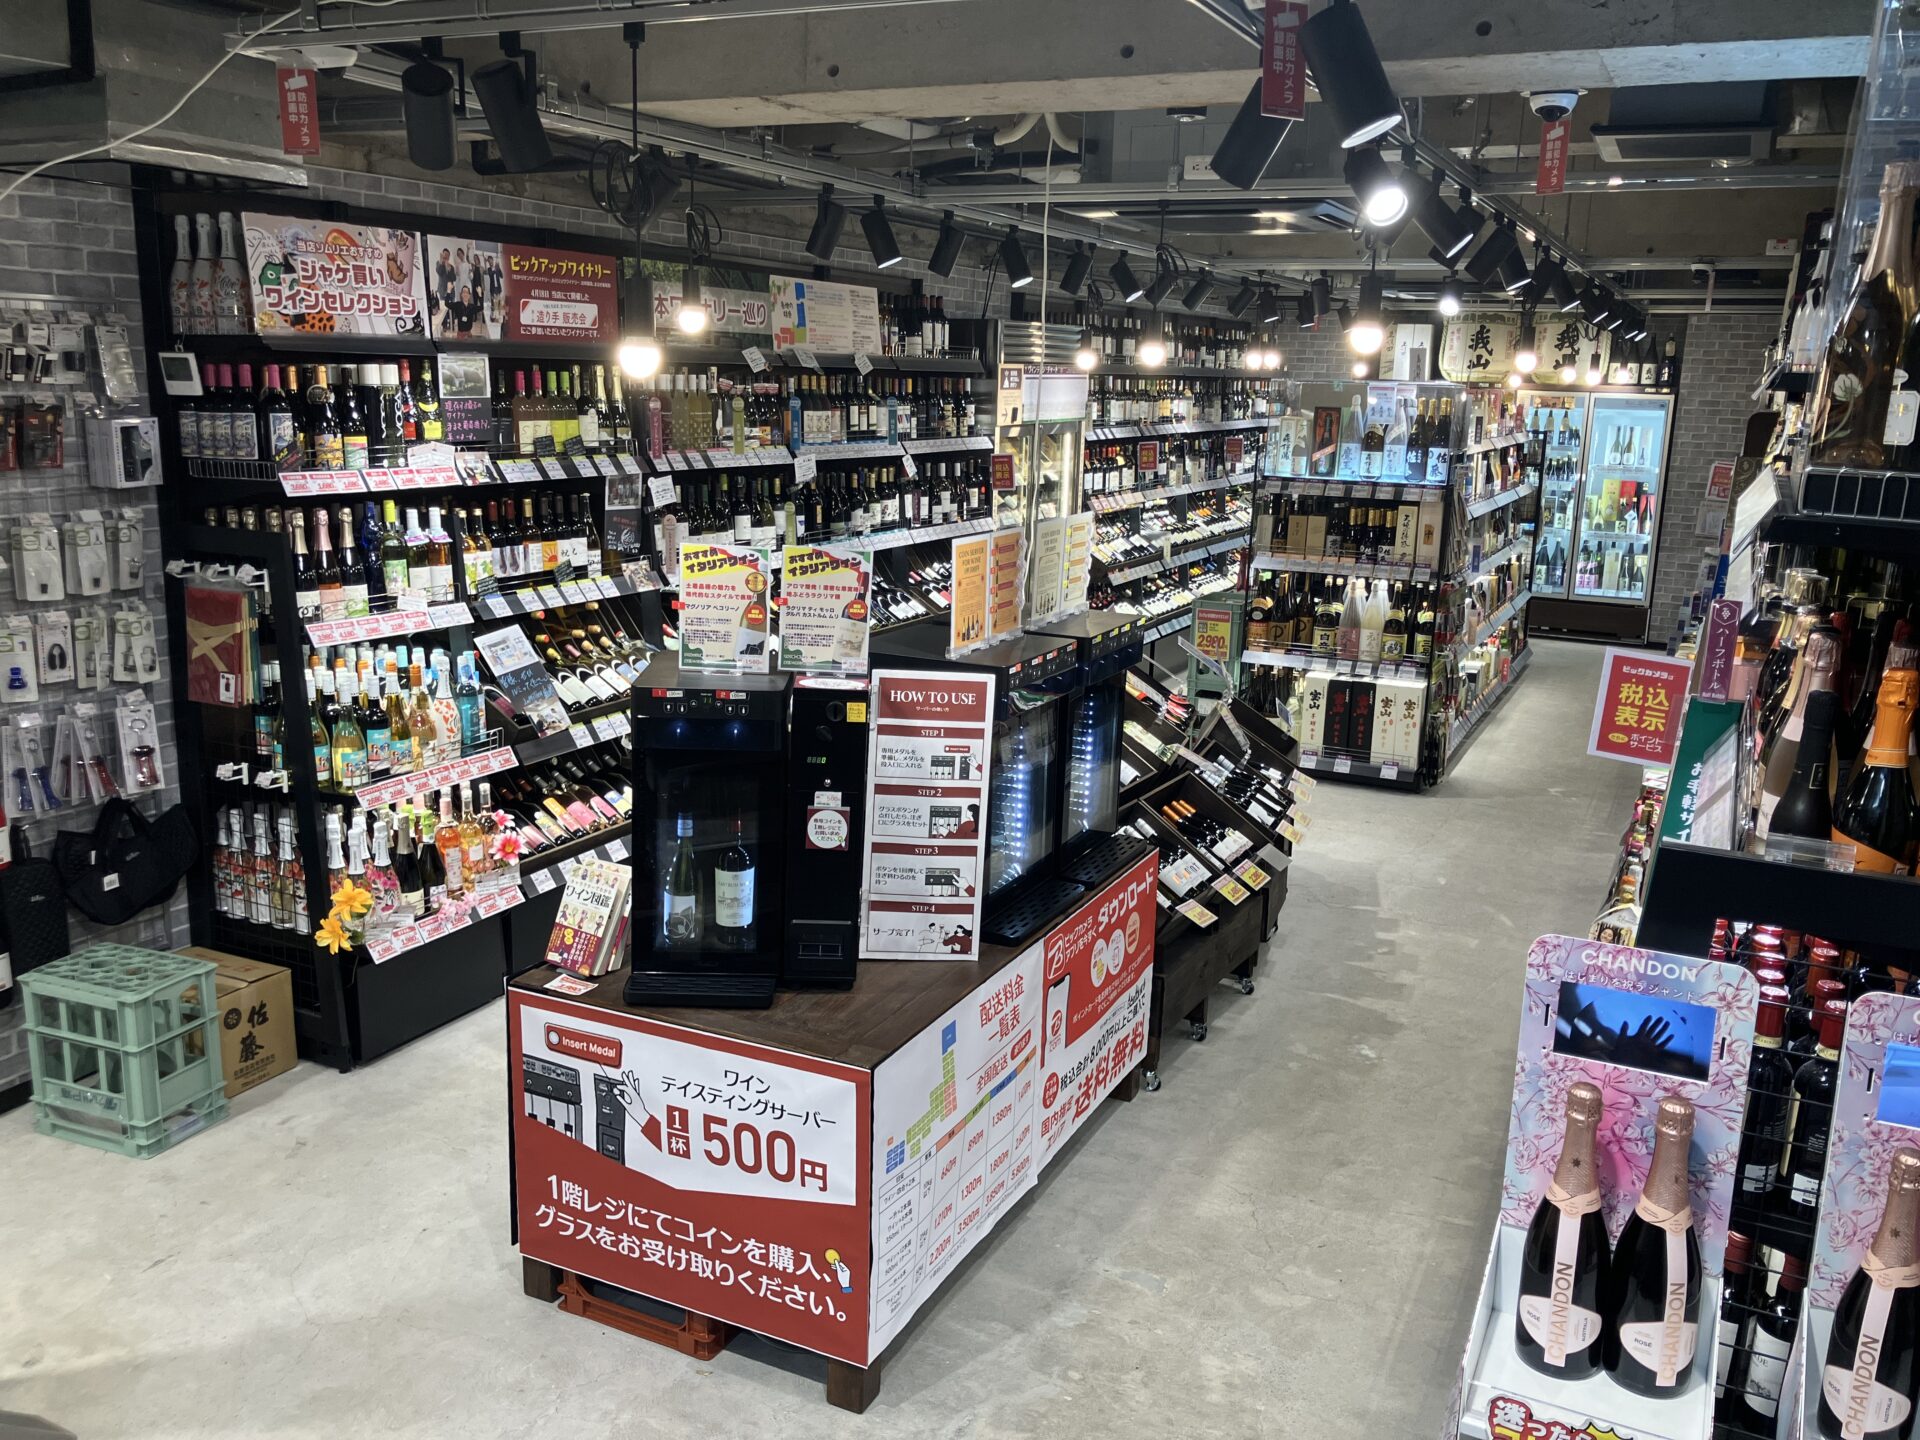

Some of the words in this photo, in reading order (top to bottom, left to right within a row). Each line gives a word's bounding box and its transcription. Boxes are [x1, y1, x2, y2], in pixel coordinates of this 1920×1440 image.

[1284, 32, 1296, 104] 防犯カメラ
[297, 91, 310, 146] 防犯カメラ
[297, 240, 383, 260] 当店ソムリエおすすめ
[300, 259, 386, 287] ジャケ買い
[510, 255, 612, 279] ピックアップワイナリー
[264, 287, 417, 316] ワインセレクション
[683, 548, 718, 561] おすすめ
[686, 553, 759, 573] イタリアワイン
[788, 557, 861, 577] イタリアワイン
[789, 551, 823, 564] おすすめ
[1708, 628, 1729, 690] ハーフボトル
[890, 690, 926, 703] HOW
[928, 691, 948, 704] TO
[951, 693, 976, 705] USE
[1619, 682, 1669, 711] 税込
[940, 728, 944, 737] 1
[1614, 705, 1666, 731] 表示
[1630, 733, 1665, 744] ポイント
[1630, 741, 1662, 753] サービス
[936, 788, 942, 796] 2
[878, 820, 928, 828] 口にグラスをセット
[933, 847, 939, 855] 3
[566, 885, 612, 908] ワイン図鑑
[1098, 867, 1154, 933] ダウンロード
[1064, 915, 1093, 946] ビックカメラ
[1065, 925, 1098, 964] アプリを今すぐ
[1581, 950, 1697, 983] CHANDON
[979, 973, 1024, 1028] 配送料金
[1565, 971, 1702, 1001] はじまりを祝うシャンド
[988, 1004, 1020, 1042] 一覧表
[562, 1036, 587, 1053] Insert
[589, 1041, 616, 1058] Medal
[724, 1069, 771, 1094] ワイン
[976, 1052, 1008, 1095] 全国配送
[1072, 1013, 1145, 1125] 送料無料
[661, 1076, 836, 1129] テイスティングサーバー
[670, 1111, 688, 1154] 1杯
[703, 1113, 828, 1192] 500円
[547, 1174, 832, 1283] 1階レジにてコインを購入、
[535, 1205, 847, 1323] グラスをお受け取りください。
[1547, 1262, 1573, 1360] CHANDON
[1662, 1283, 1685, 1380] CHANDON
[1845, 1334, 1880, 1435] CHANDON
